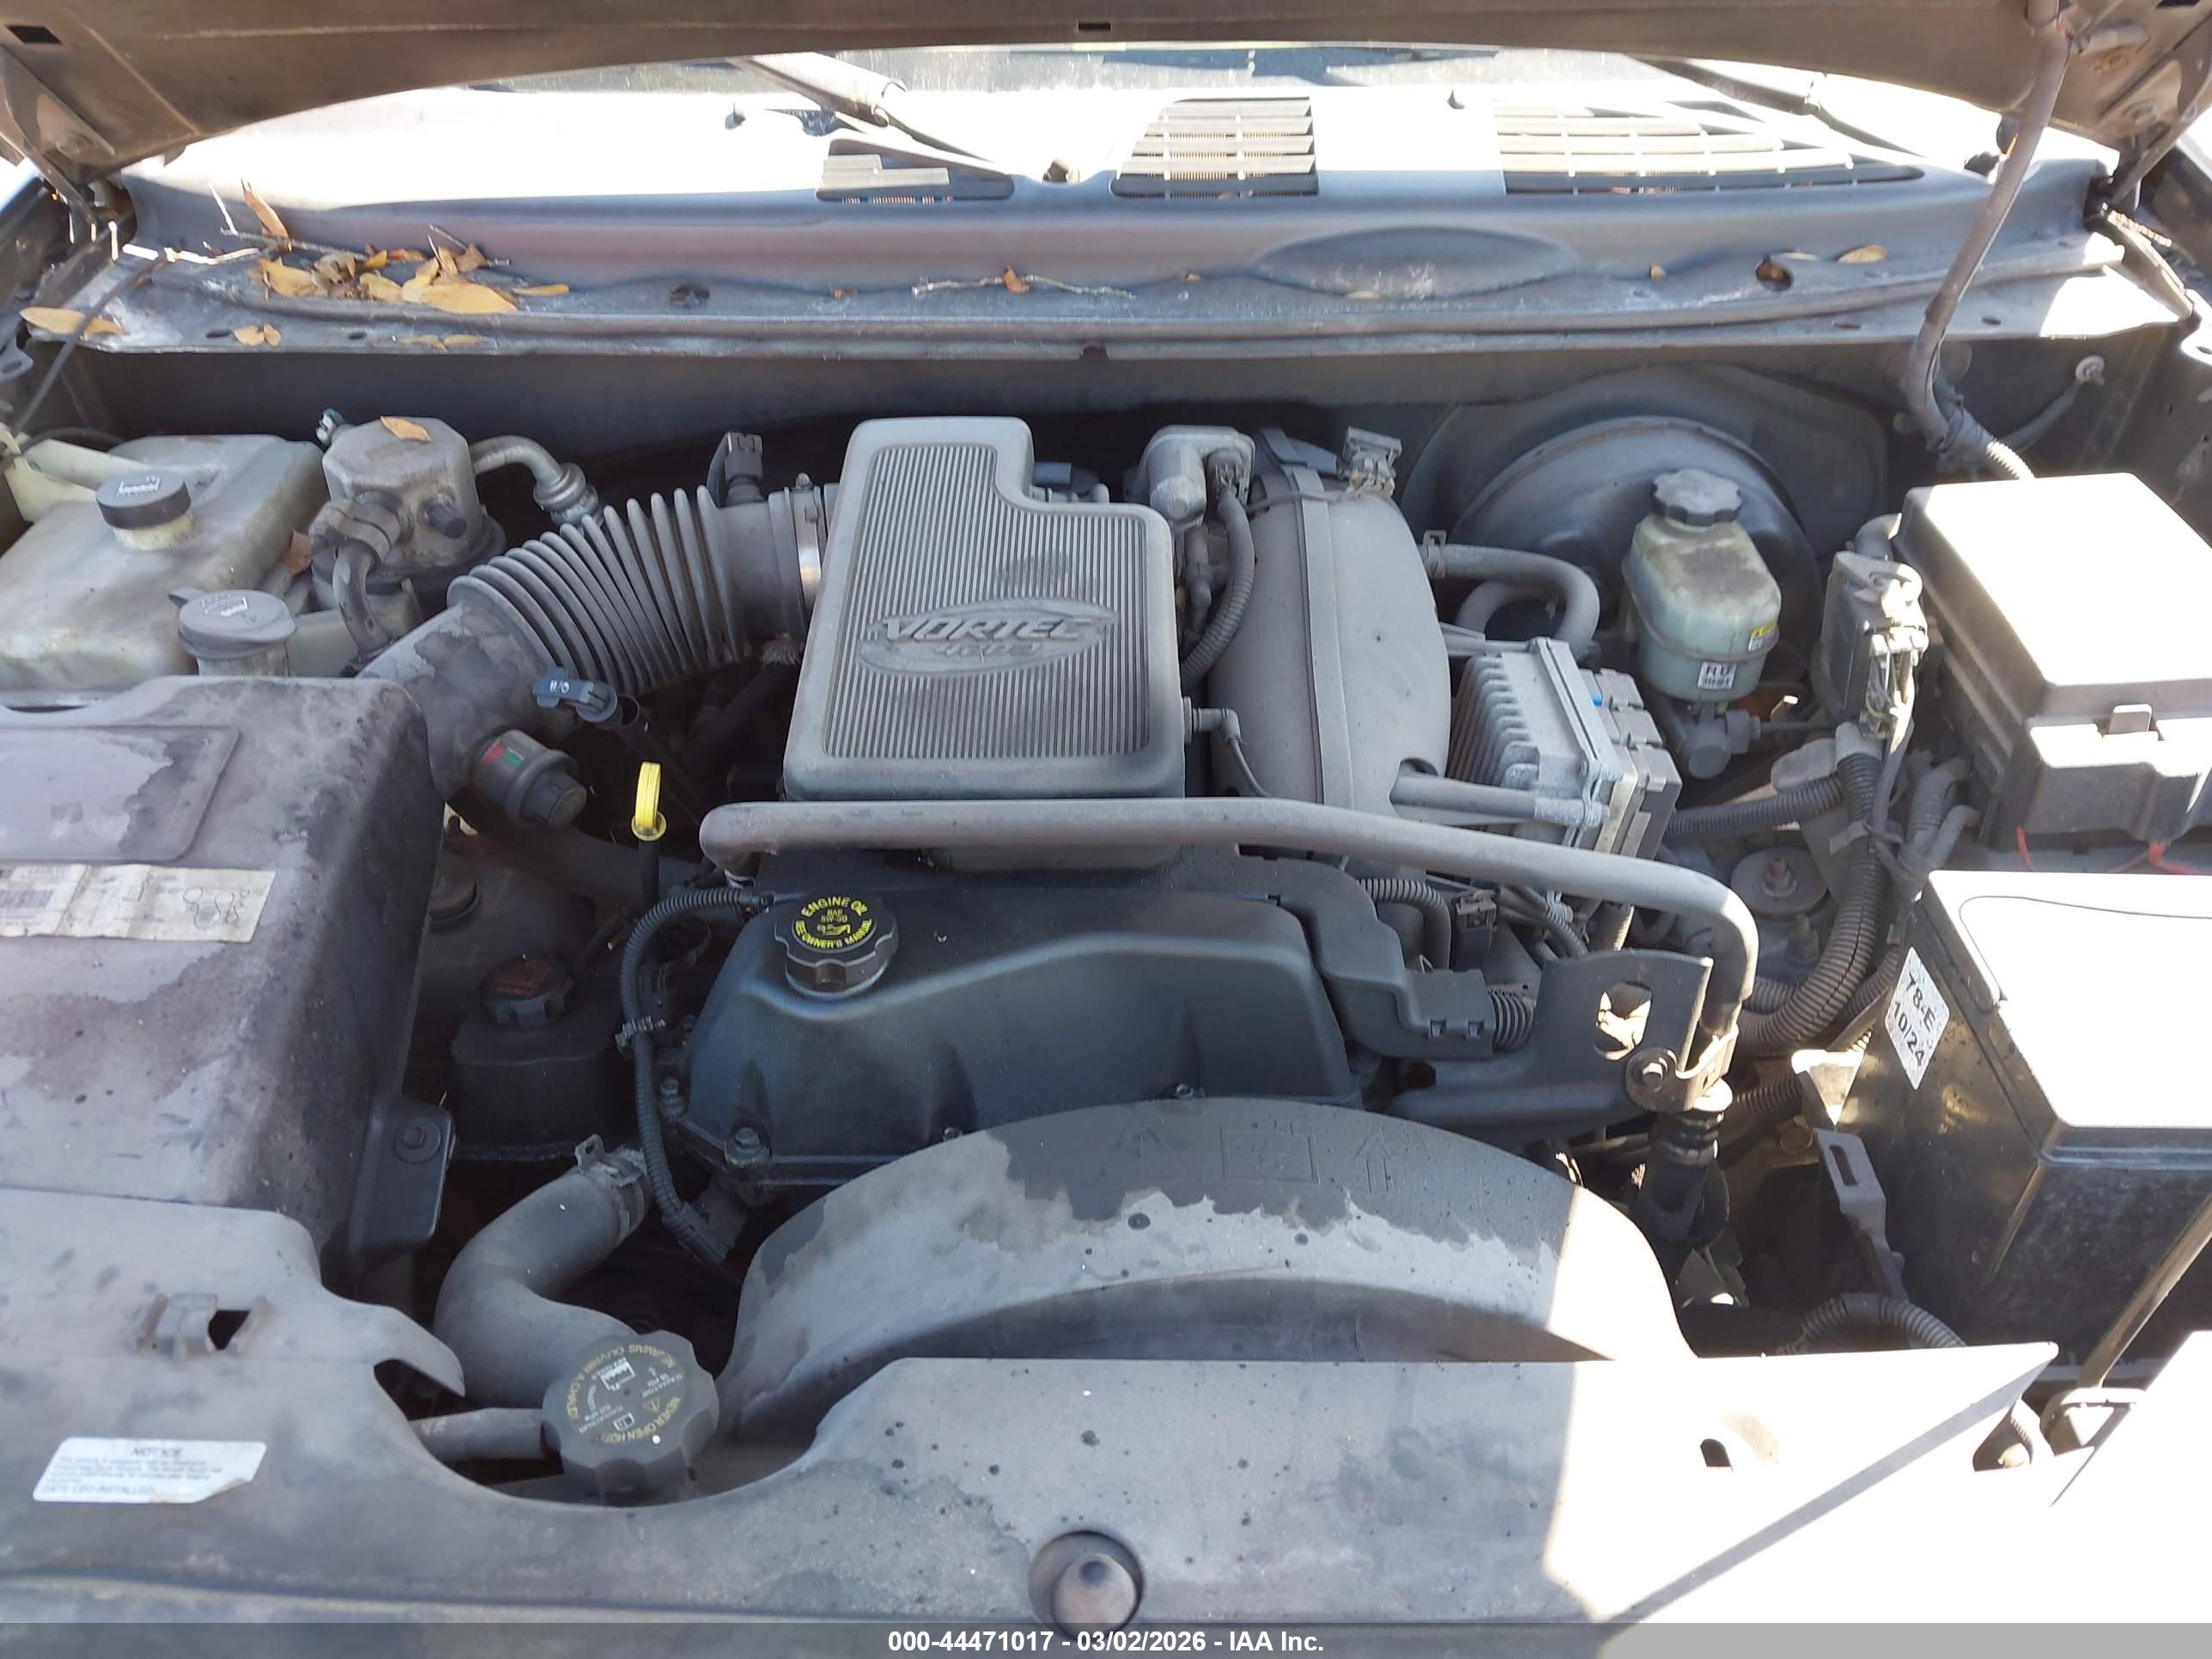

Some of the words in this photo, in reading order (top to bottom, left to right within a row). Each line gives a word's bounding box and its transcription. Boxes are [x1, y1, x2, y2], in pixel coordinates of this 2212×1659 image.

[883, 617, 1092, 642] VORTEC
[800, 896, 851, 917] ENGINE
[851, 900, 868, 917] OIL
[628, 1422, 656, 1442] OPEN
